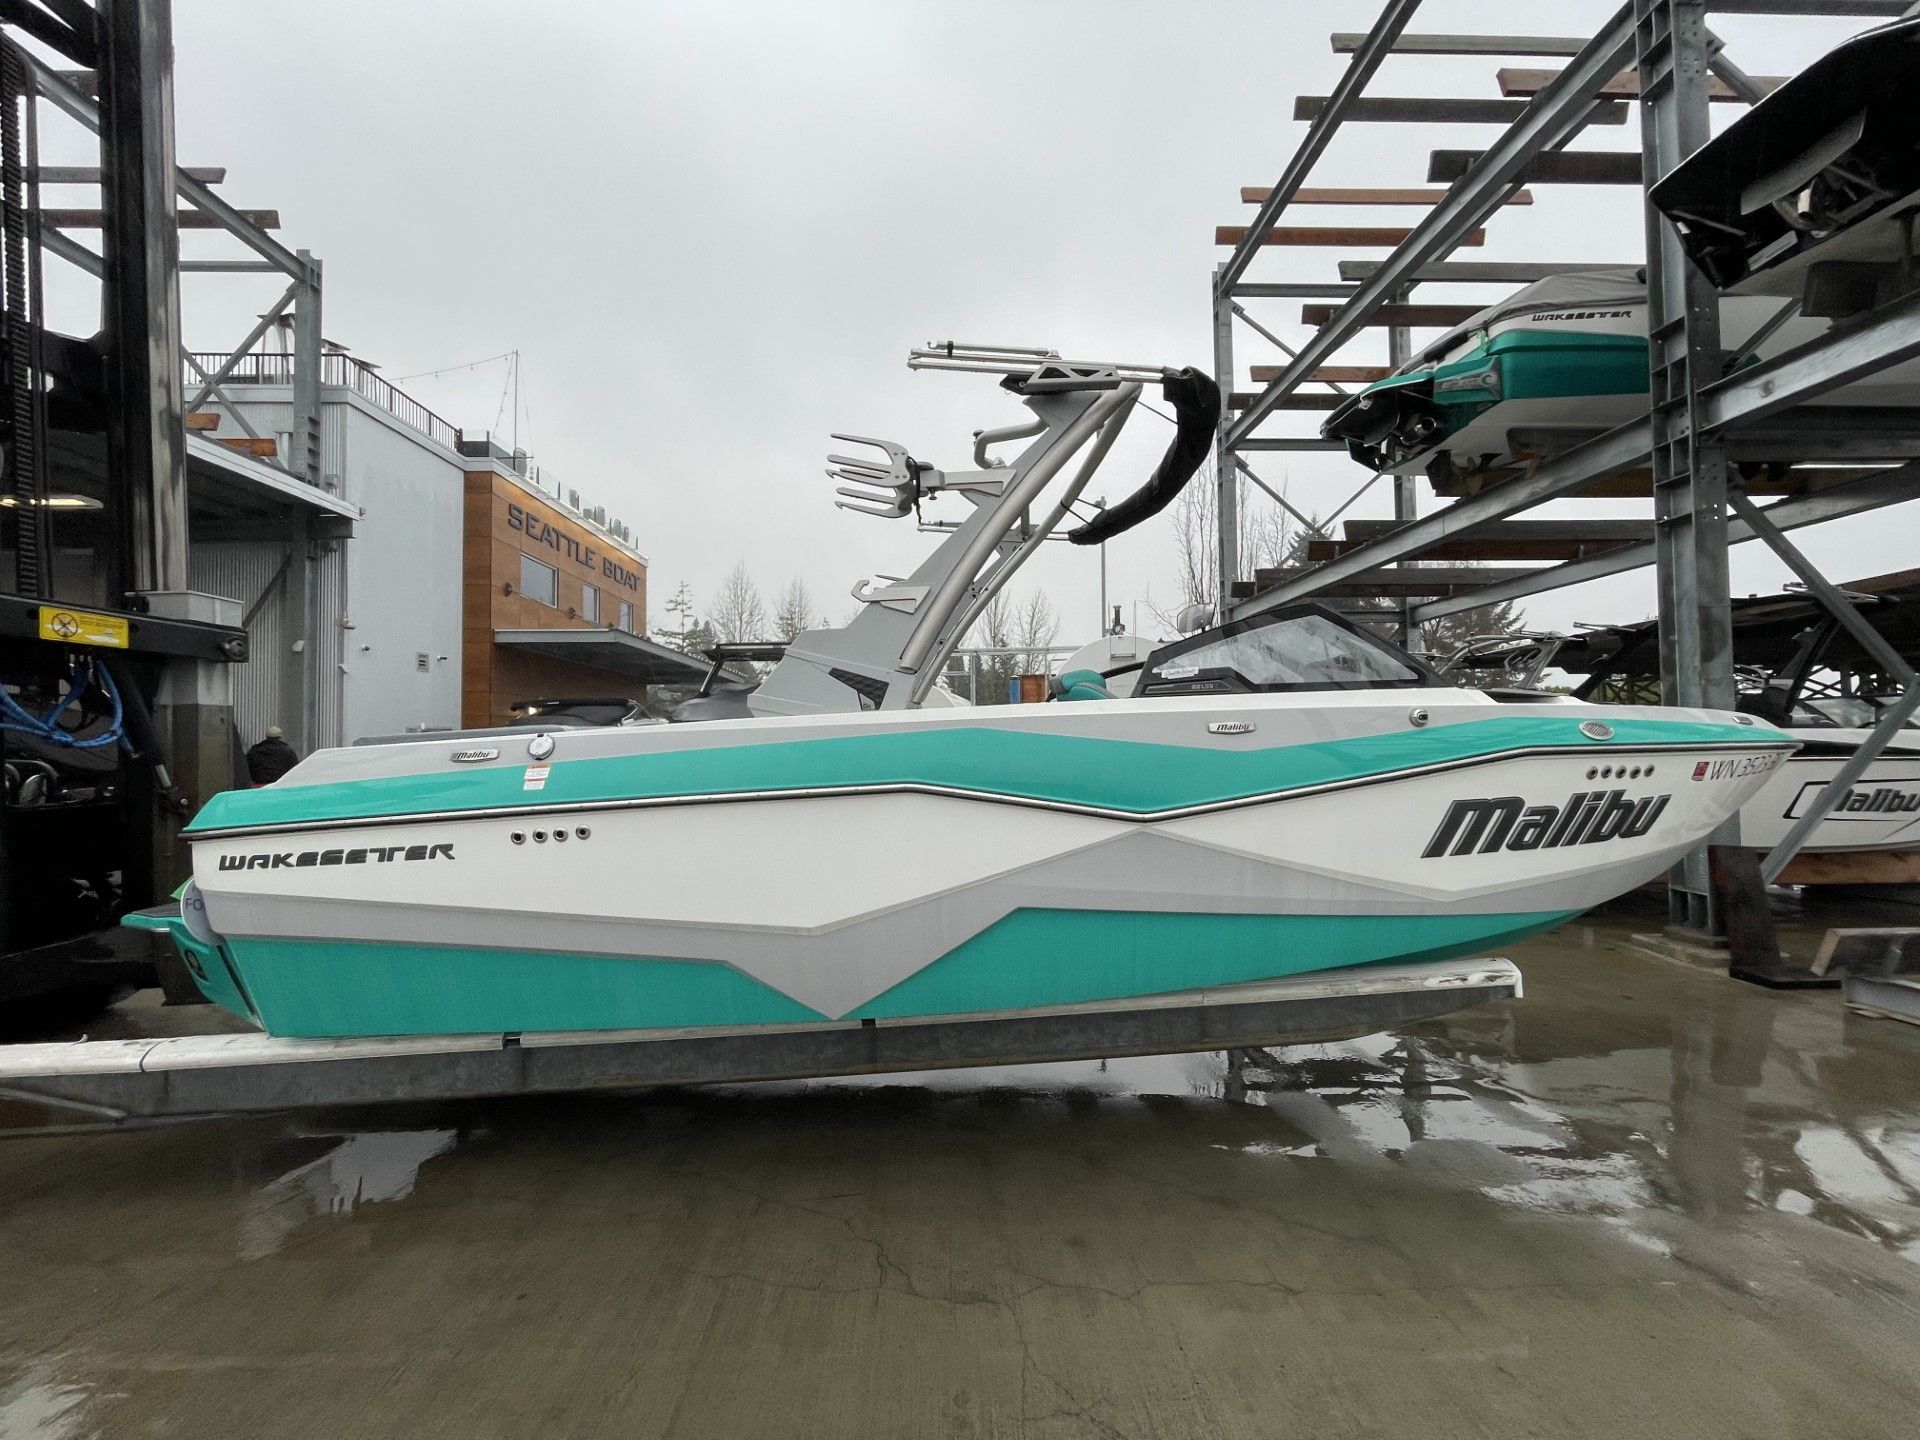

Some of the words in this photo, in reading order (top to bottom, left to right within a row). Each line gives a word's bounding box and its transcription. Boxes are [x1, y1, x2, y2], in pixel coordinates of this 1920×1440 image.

[508, 503, 597, 571] SEATTLE
[603, 557, 641, 592] BOAT
[457, 751, 490, 760] Malibu
[1420, 789, 1672, 859] Malibu
[218, 842, 456, 872] WAKESETTER
